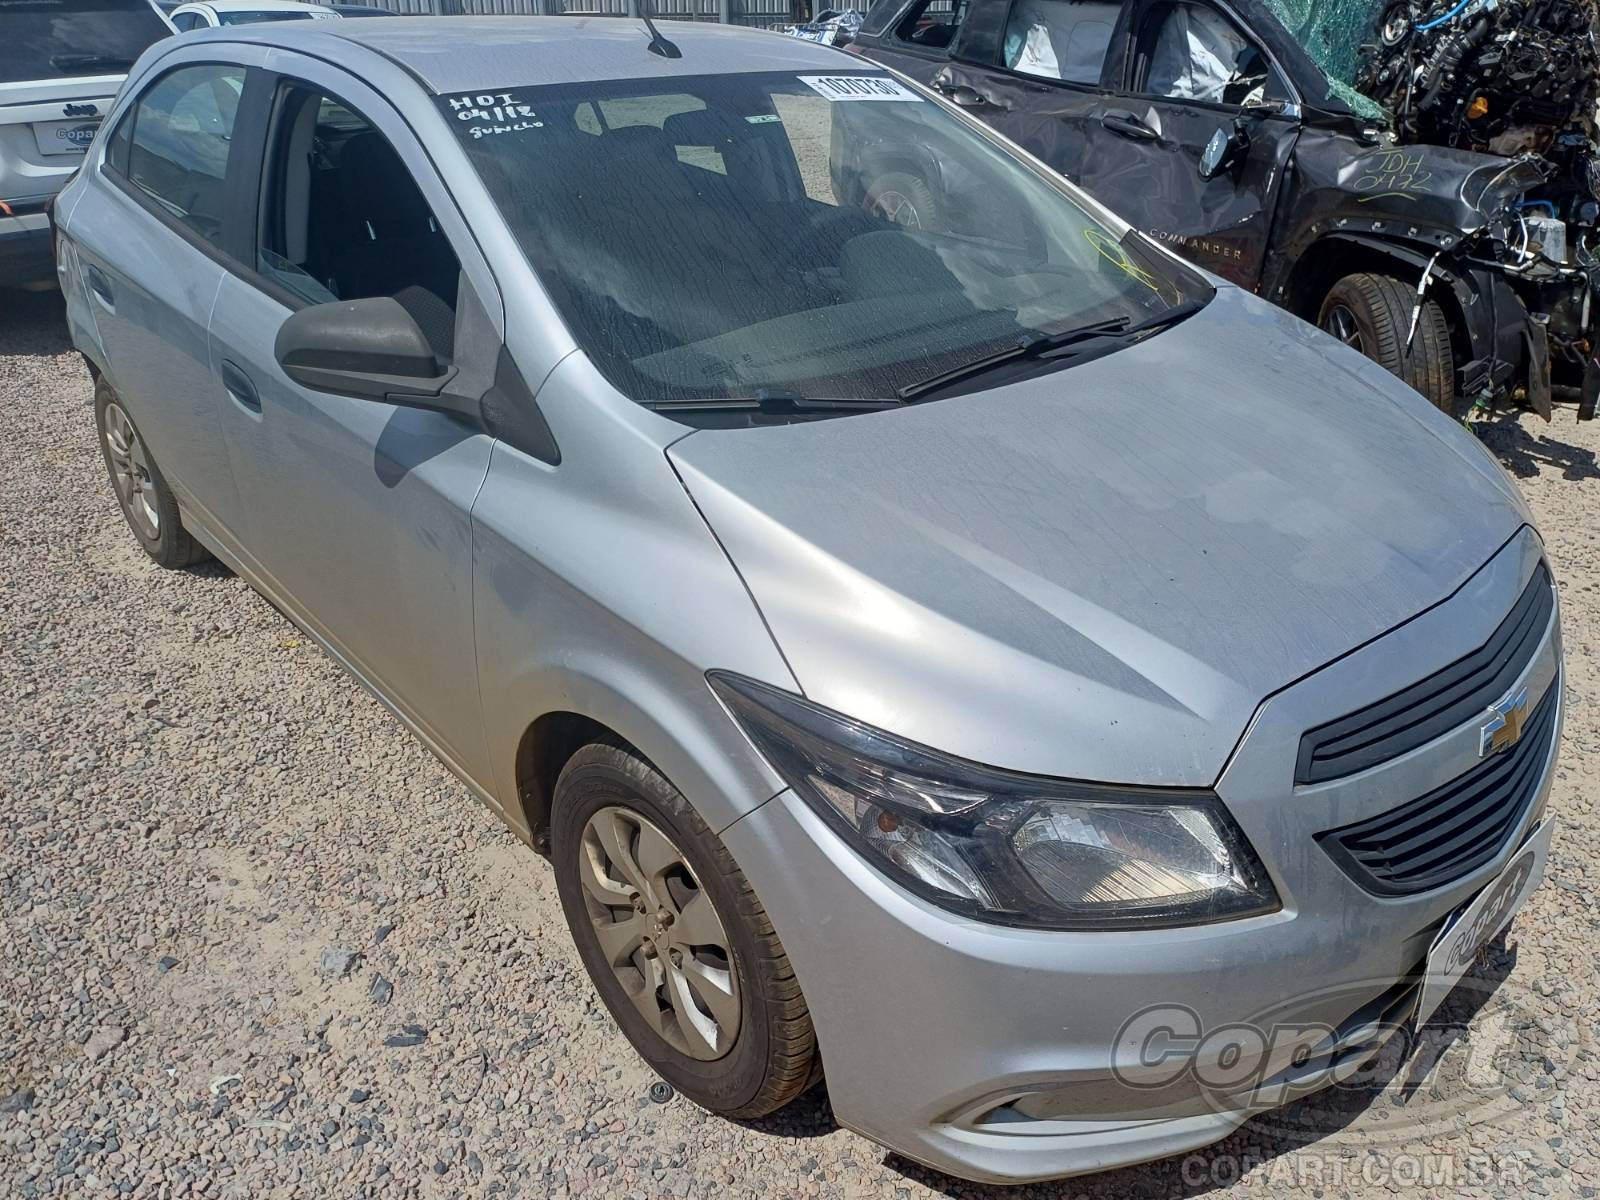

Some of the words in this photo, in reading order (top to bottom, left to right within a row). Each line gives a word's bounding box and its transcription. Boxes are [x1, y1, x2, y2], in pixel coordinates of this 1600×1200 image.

[1365, 150, 1425, 174] JDH
[1149, 228, 1241, 259] COMMANDER
[1444, 865, 1523, 976] Copart
